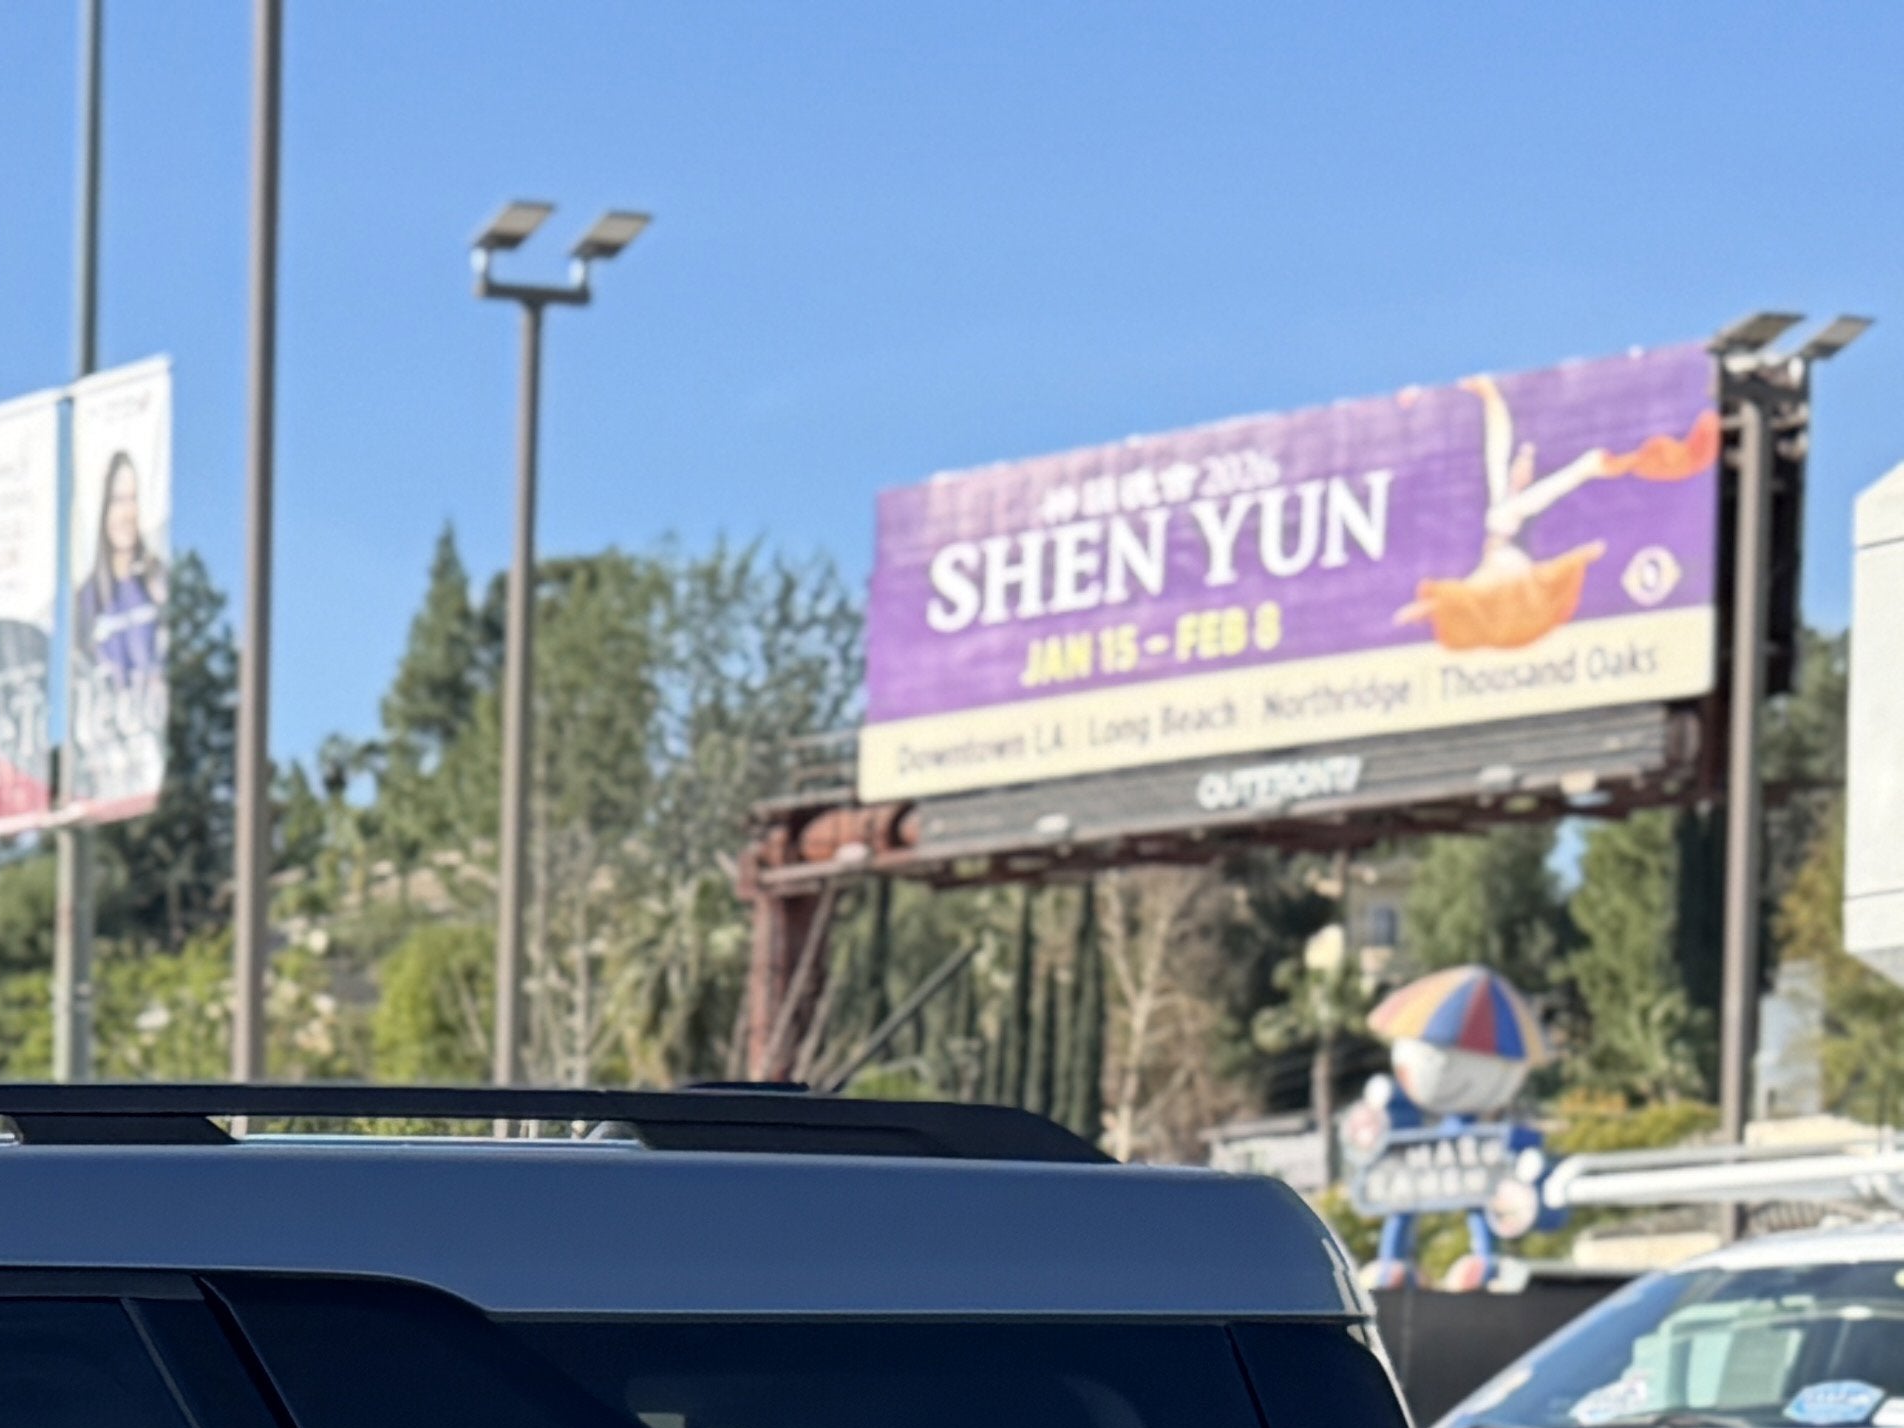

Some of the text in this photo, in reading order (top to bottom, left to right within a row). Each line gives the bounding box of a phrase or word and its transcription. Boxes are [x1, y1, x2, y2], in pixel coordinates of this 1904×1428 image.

[926, 518, 1165, 634] SHEN
[1194, 469, 1395, 588] YUN
[897, 644, 1658, 776] Downtown LA Long Beach Northridge Thousand Oaks
[1020, 634, 1092, 688] JAN
[1099, 622, 1141, 674] 15
[1175, 606, 1249, 663] FEB
[1254, 600, 1283, 651] 8
